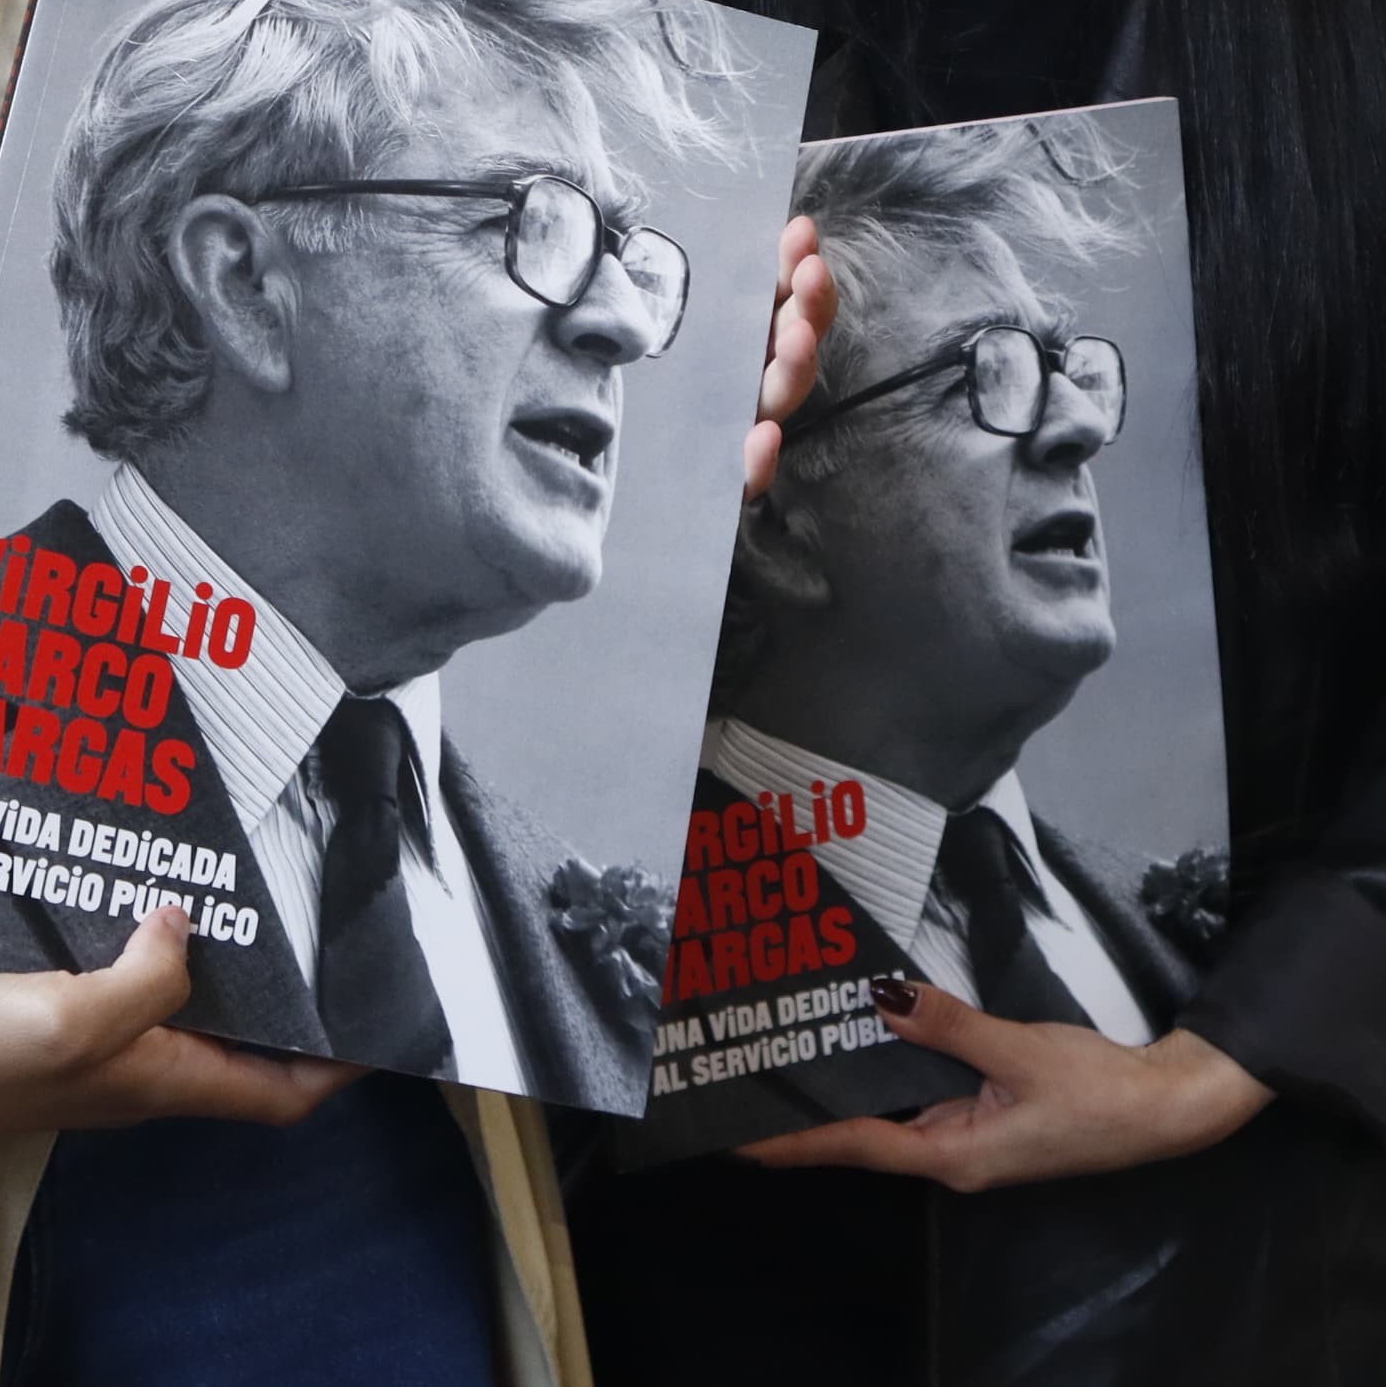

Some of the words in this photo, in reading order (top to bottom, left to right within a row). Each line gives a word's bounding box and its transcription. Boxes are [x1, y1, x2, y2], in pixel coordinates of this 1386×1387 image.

[674, 851, 820, 939] ARCO
[653, 1062, 689, 1097] AL
[820, 1015, 900, 1057] PÚBL
